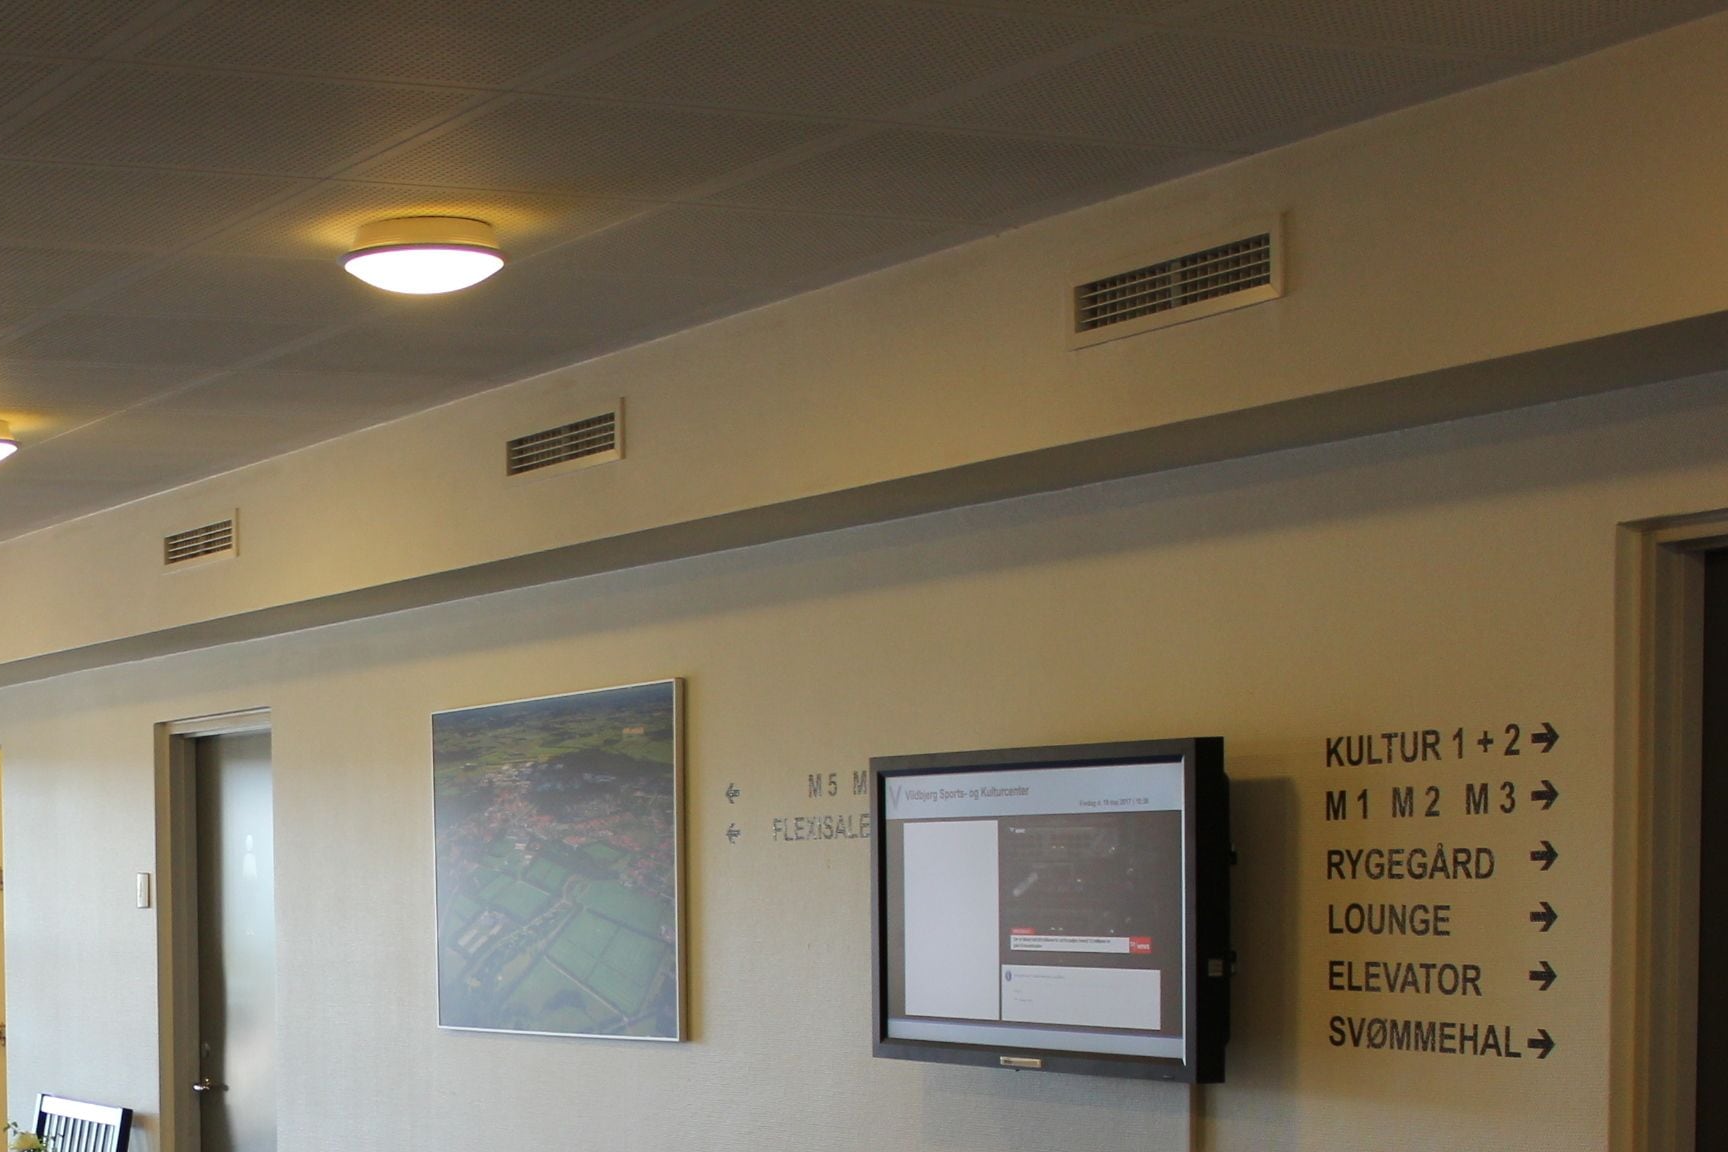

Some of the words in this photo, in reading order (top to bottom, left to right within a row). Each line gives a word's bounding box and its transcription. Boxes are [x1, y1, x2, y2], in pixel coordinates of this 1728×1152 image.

[1325, 729, 1442, 768] KULTUR
[1451, 727, 1465, 760] 1
[1503, 723, 1521, 757] 2
[905, 790, 938, 803] Vildbjerg
[939, 788, 968, 801] Sports-
[969, 790, 980, 801] og
[980, 785, 1030, 798] Kulturcenter
[1326, 842, 1496, 880] RYGEGÅRD
[1327, 902, 1452, 938] LOUNGE
[1328, 960, 1483, 997] ELEVATOR
[1328, 1015, 1523, 1059] SVØMMEHAL
